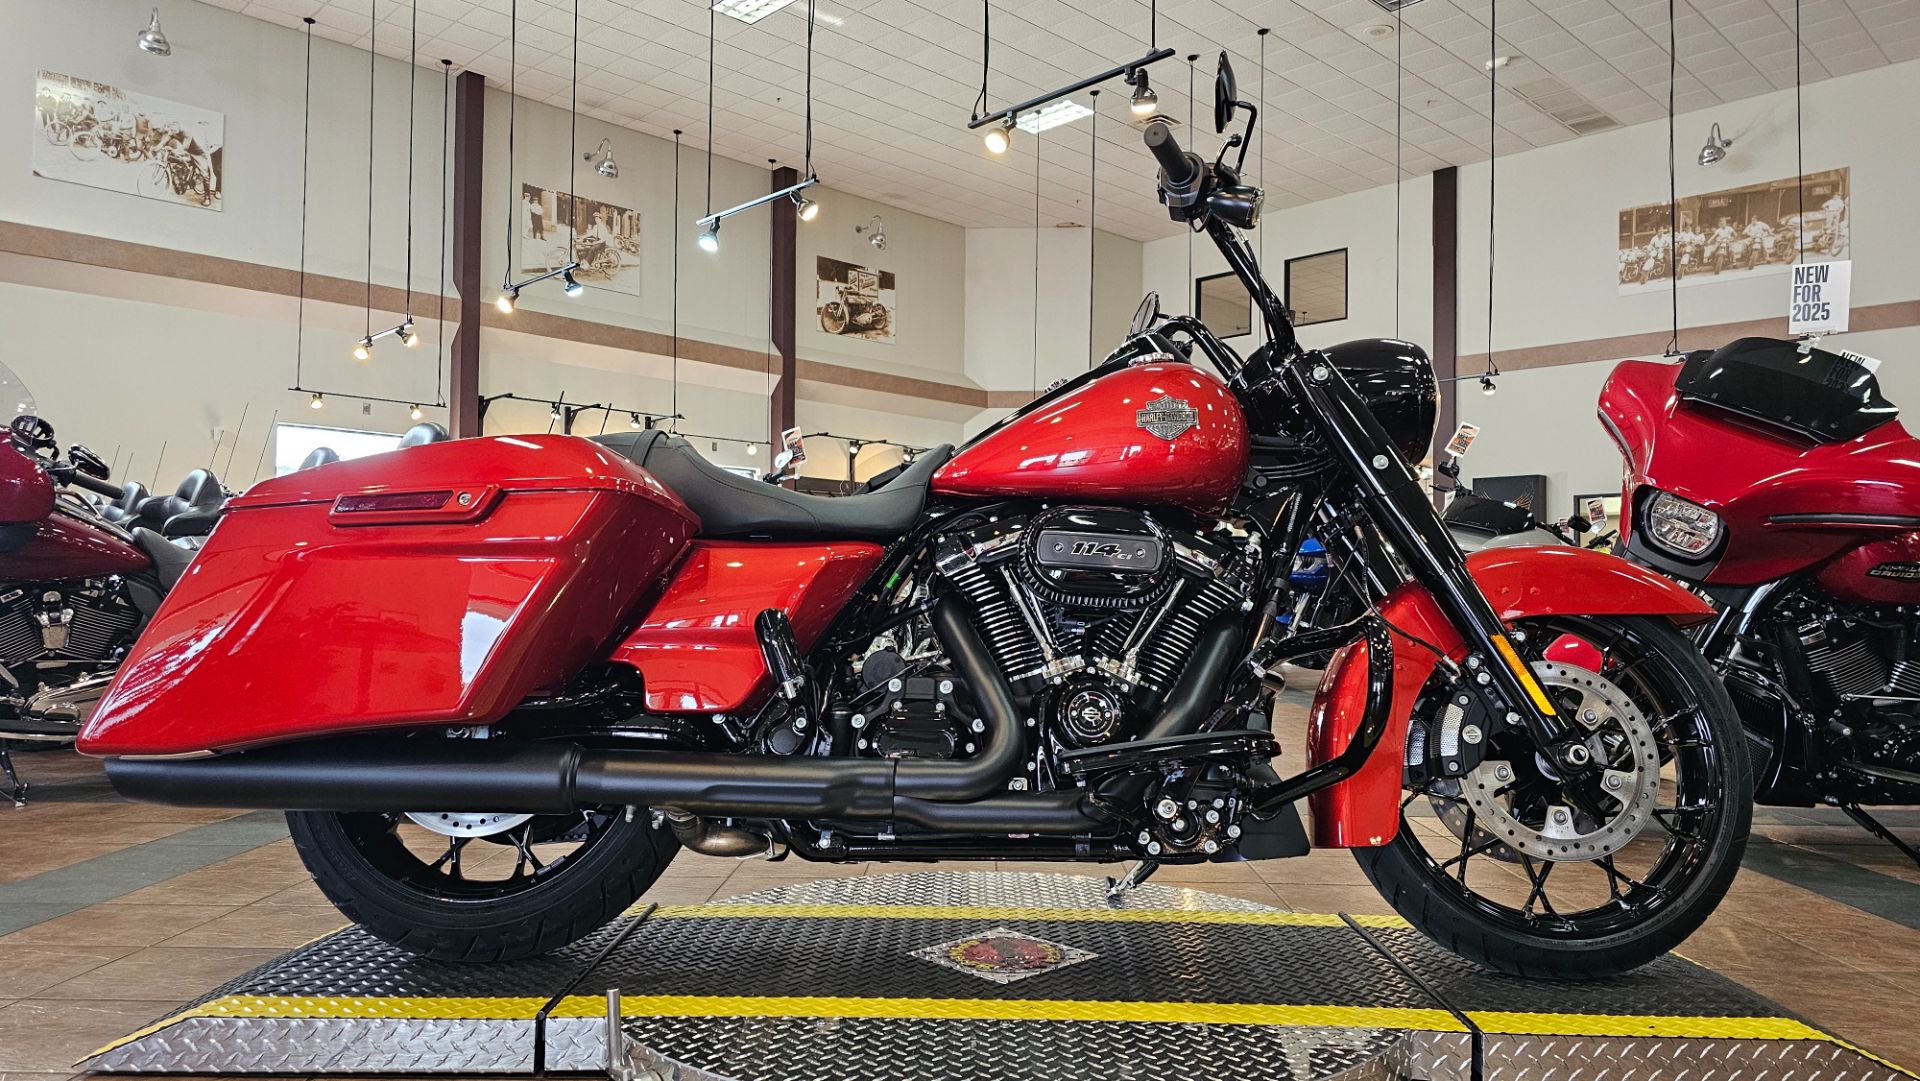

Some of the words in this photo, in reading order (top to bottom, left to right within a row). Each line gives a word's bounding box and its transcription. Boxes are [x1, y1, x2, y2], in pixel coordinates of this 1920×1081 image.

[1794, 265, 1830, 285] NEW
[1793, 284, 1821, 303] FOR
[1792, 302, 1830, 322] 2025
[1071, 541, 1121, 557] 114
